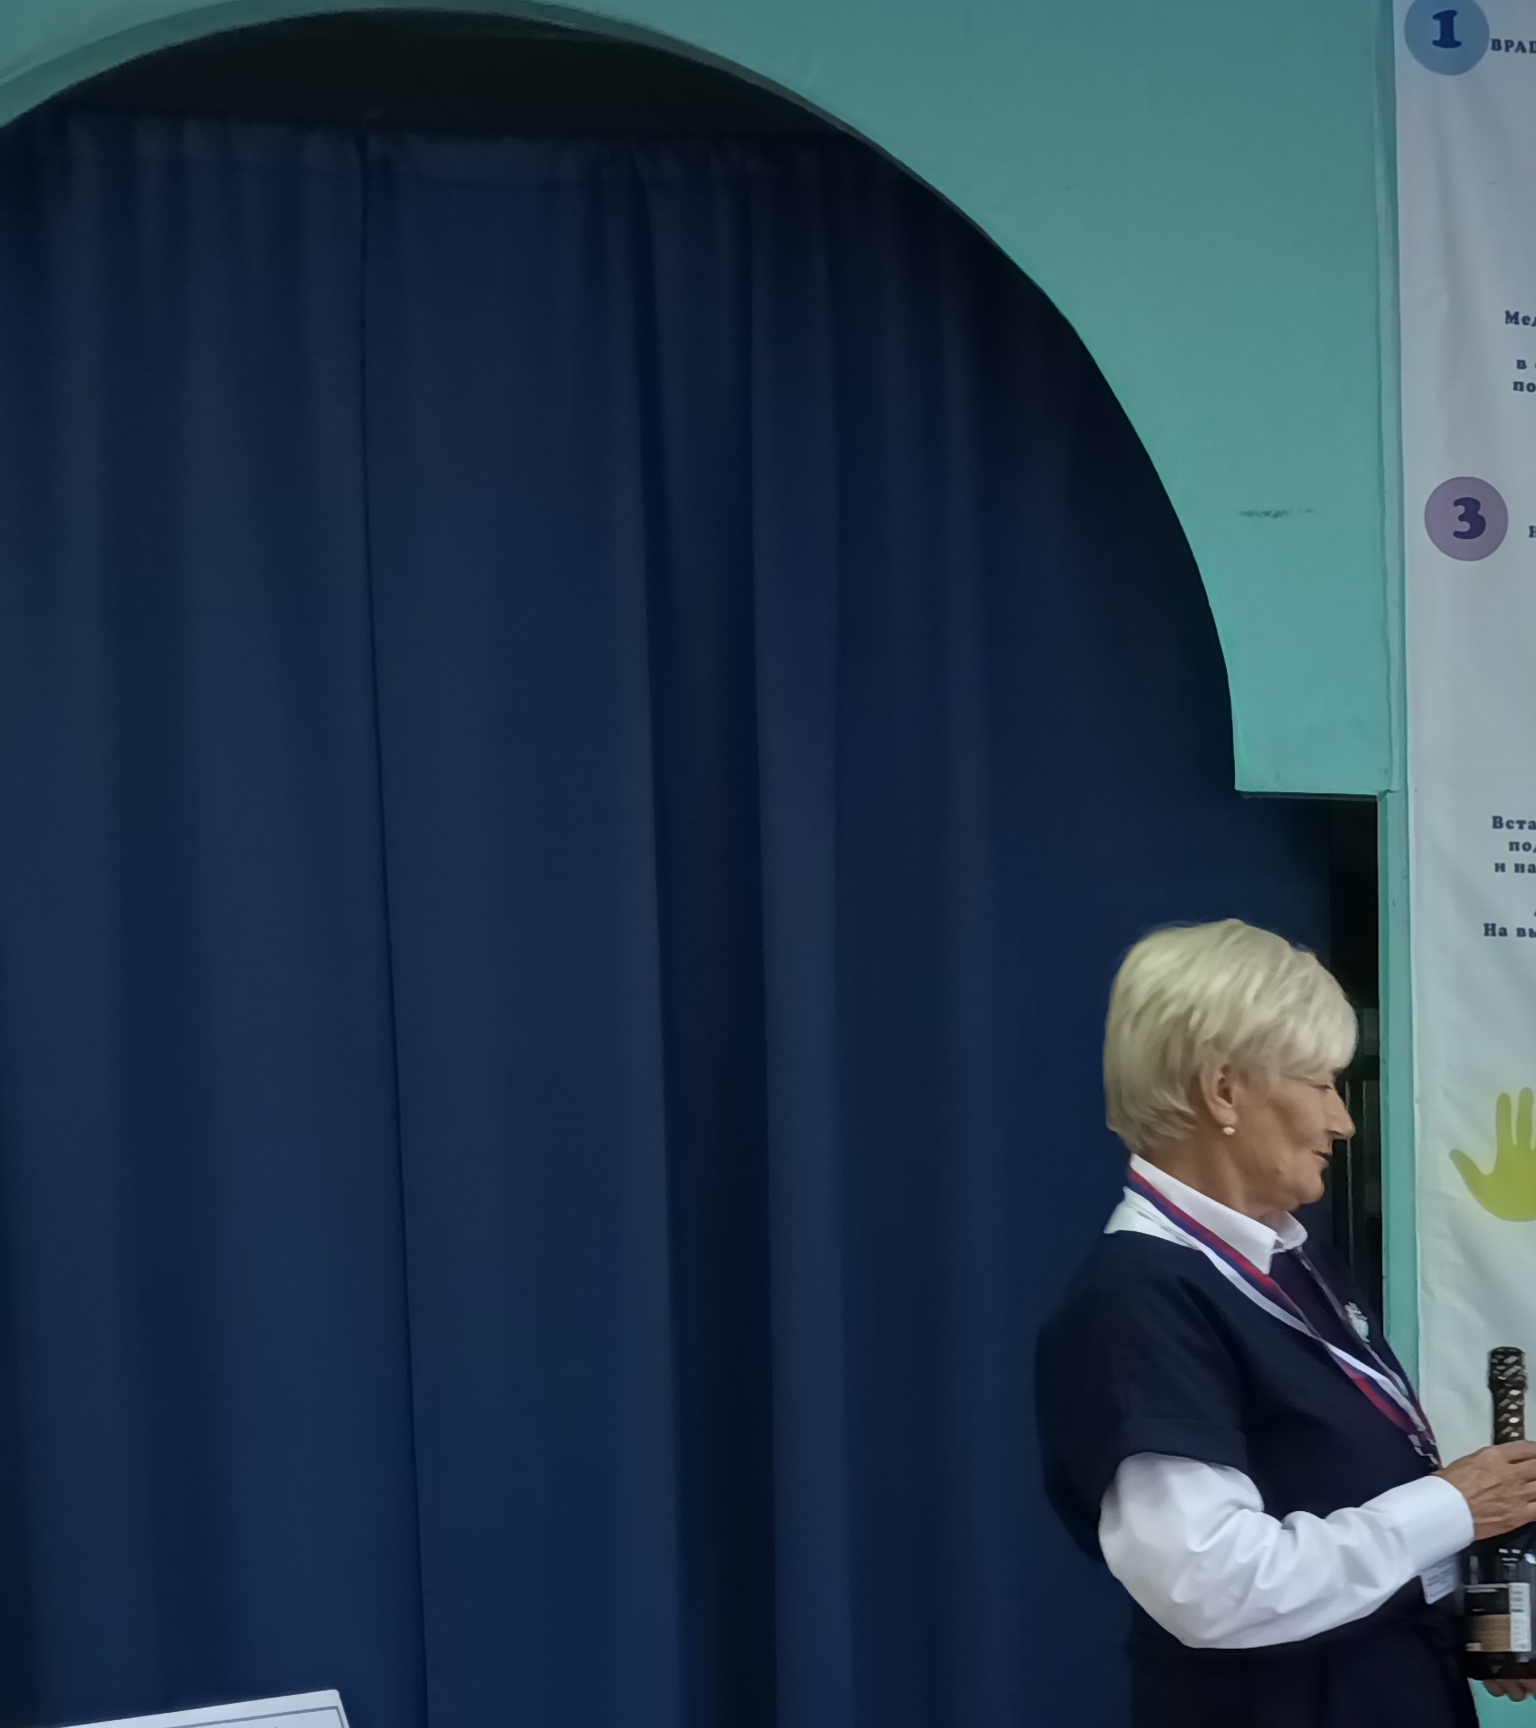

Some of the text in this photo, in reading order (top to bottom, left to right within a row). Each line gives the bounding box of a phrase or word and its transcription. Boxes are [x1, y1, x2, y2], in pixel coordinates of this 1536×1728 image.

[1432, 9, 1462, 48] 1
[1516, 359, 1527, 370] в
[1452, 496, 1487, 540] 3
[1494, 862, 1506, 873] и
[1483, 923, 1508, 938] На
